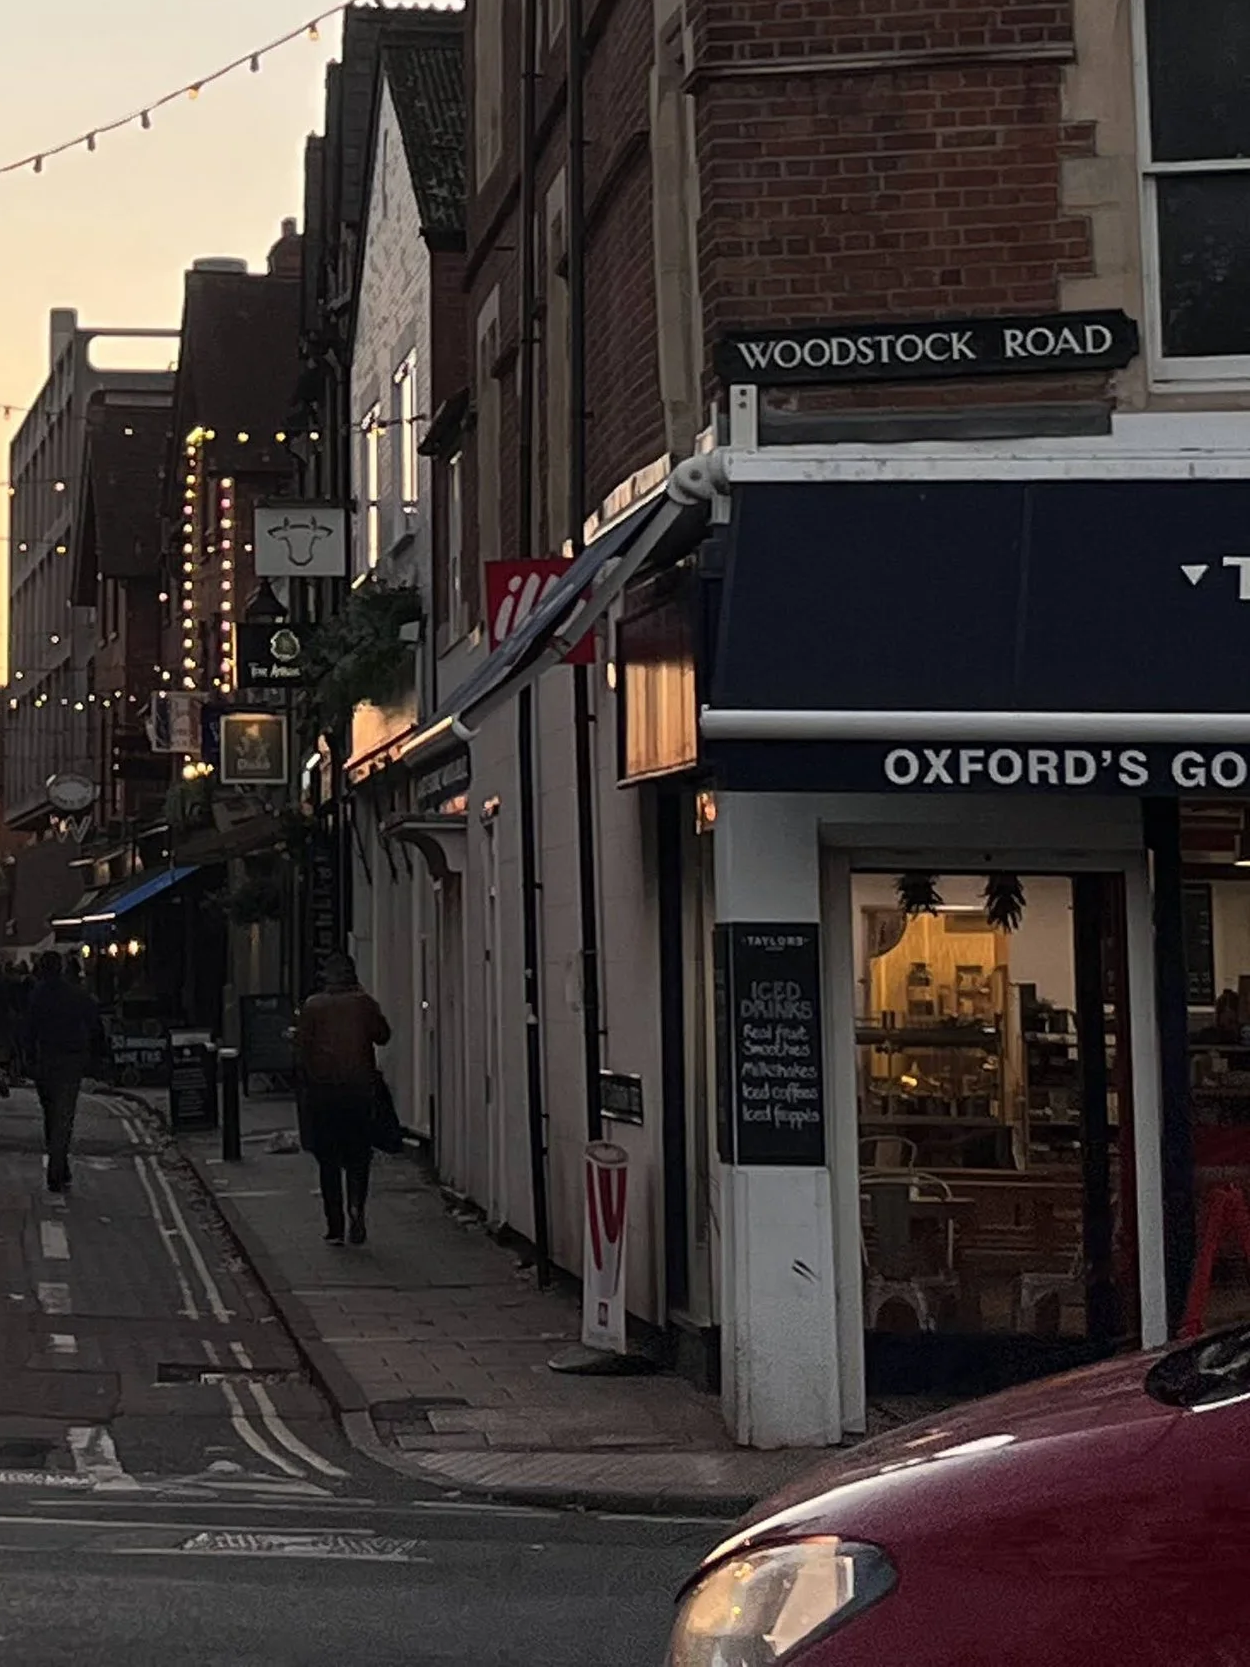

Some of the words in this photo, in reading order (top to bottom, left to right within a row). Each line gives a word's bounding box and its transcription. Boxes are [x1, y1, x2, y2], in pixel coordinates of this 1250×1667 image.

[736, 331, 978, 370] WOODSTOCK
[1003, 323, 1113, 359] ROAD
[883, 747, 1150, 789] OXFORD'S
[1171, 749, 1249, 790] GO
[751, 980, 802, 1001] ICED
[740, 998, 814, 1020] DRINKS
[742, 1023, 772, 1040] Real
[741, 1081, 770, 1100] Iced
[741, 1103, 772, 1122] Iced
